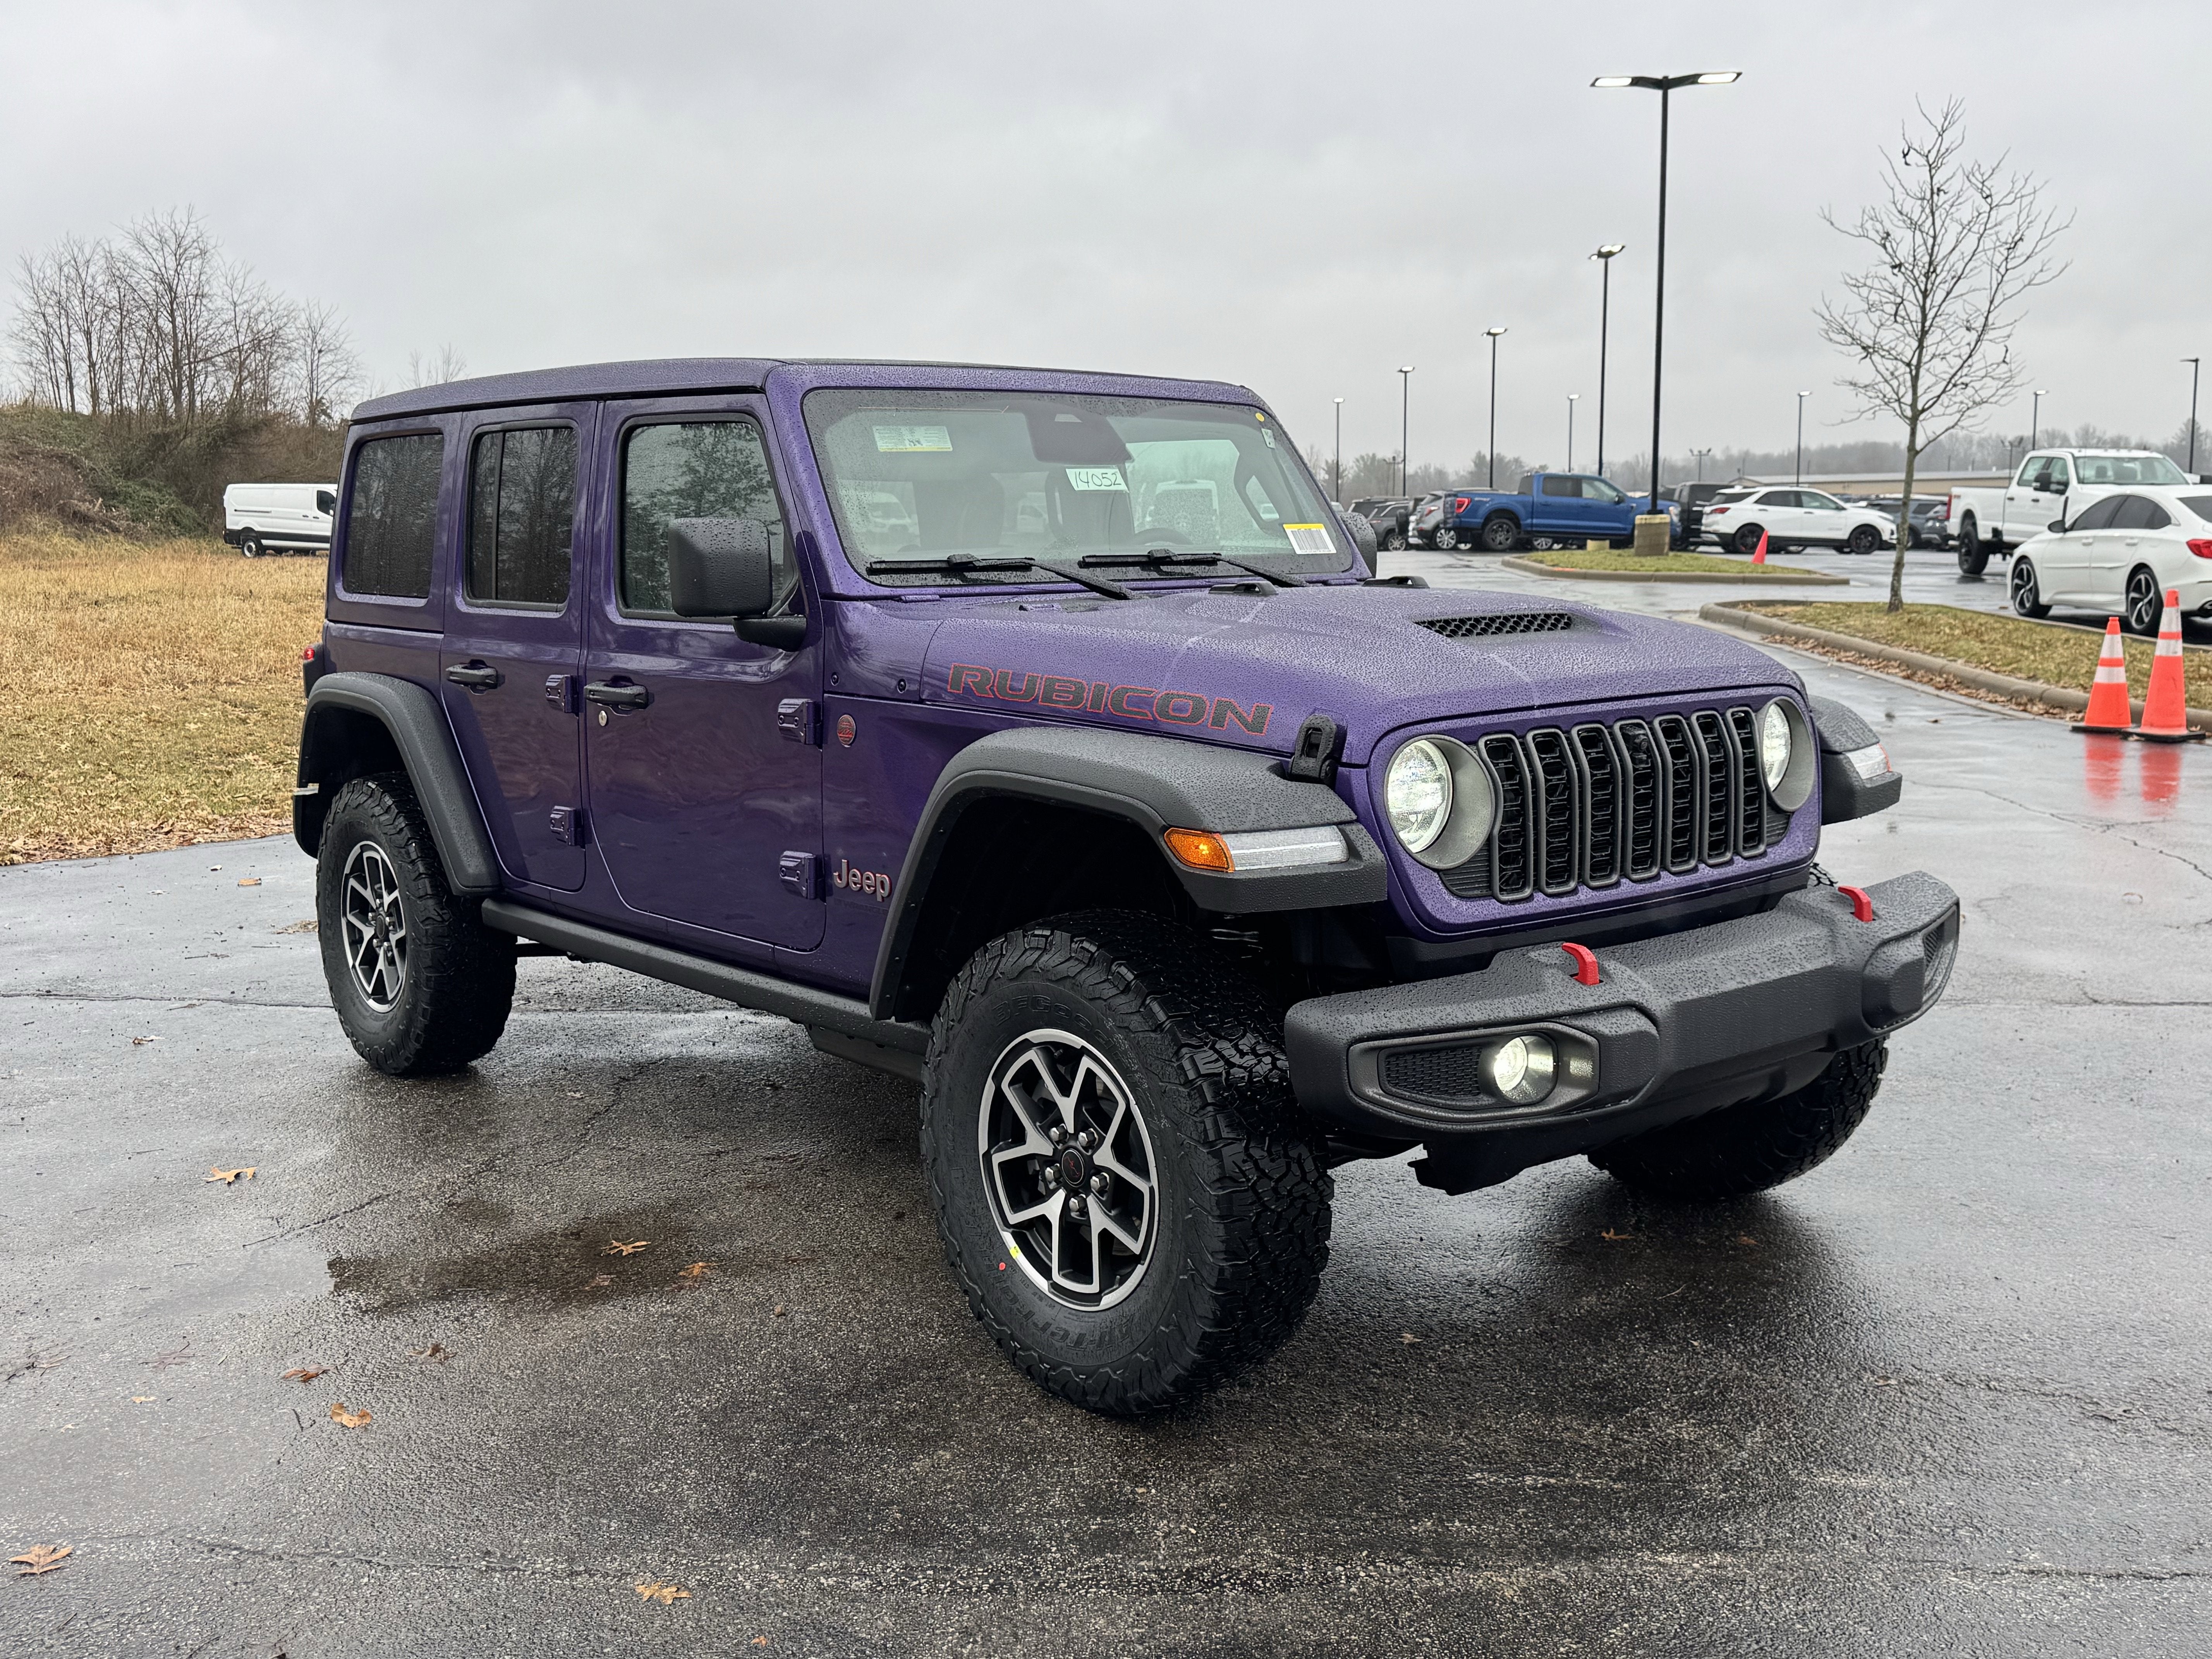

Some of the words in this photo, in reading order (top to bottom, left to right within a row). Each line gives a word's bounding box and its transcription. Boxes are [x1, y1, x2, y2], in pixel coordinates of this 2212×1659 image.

[1075, 471, 1122, 488] 14052
[947, 663, 1274, 736] RUBICON
[833, 859, 892, 902] Jeep
